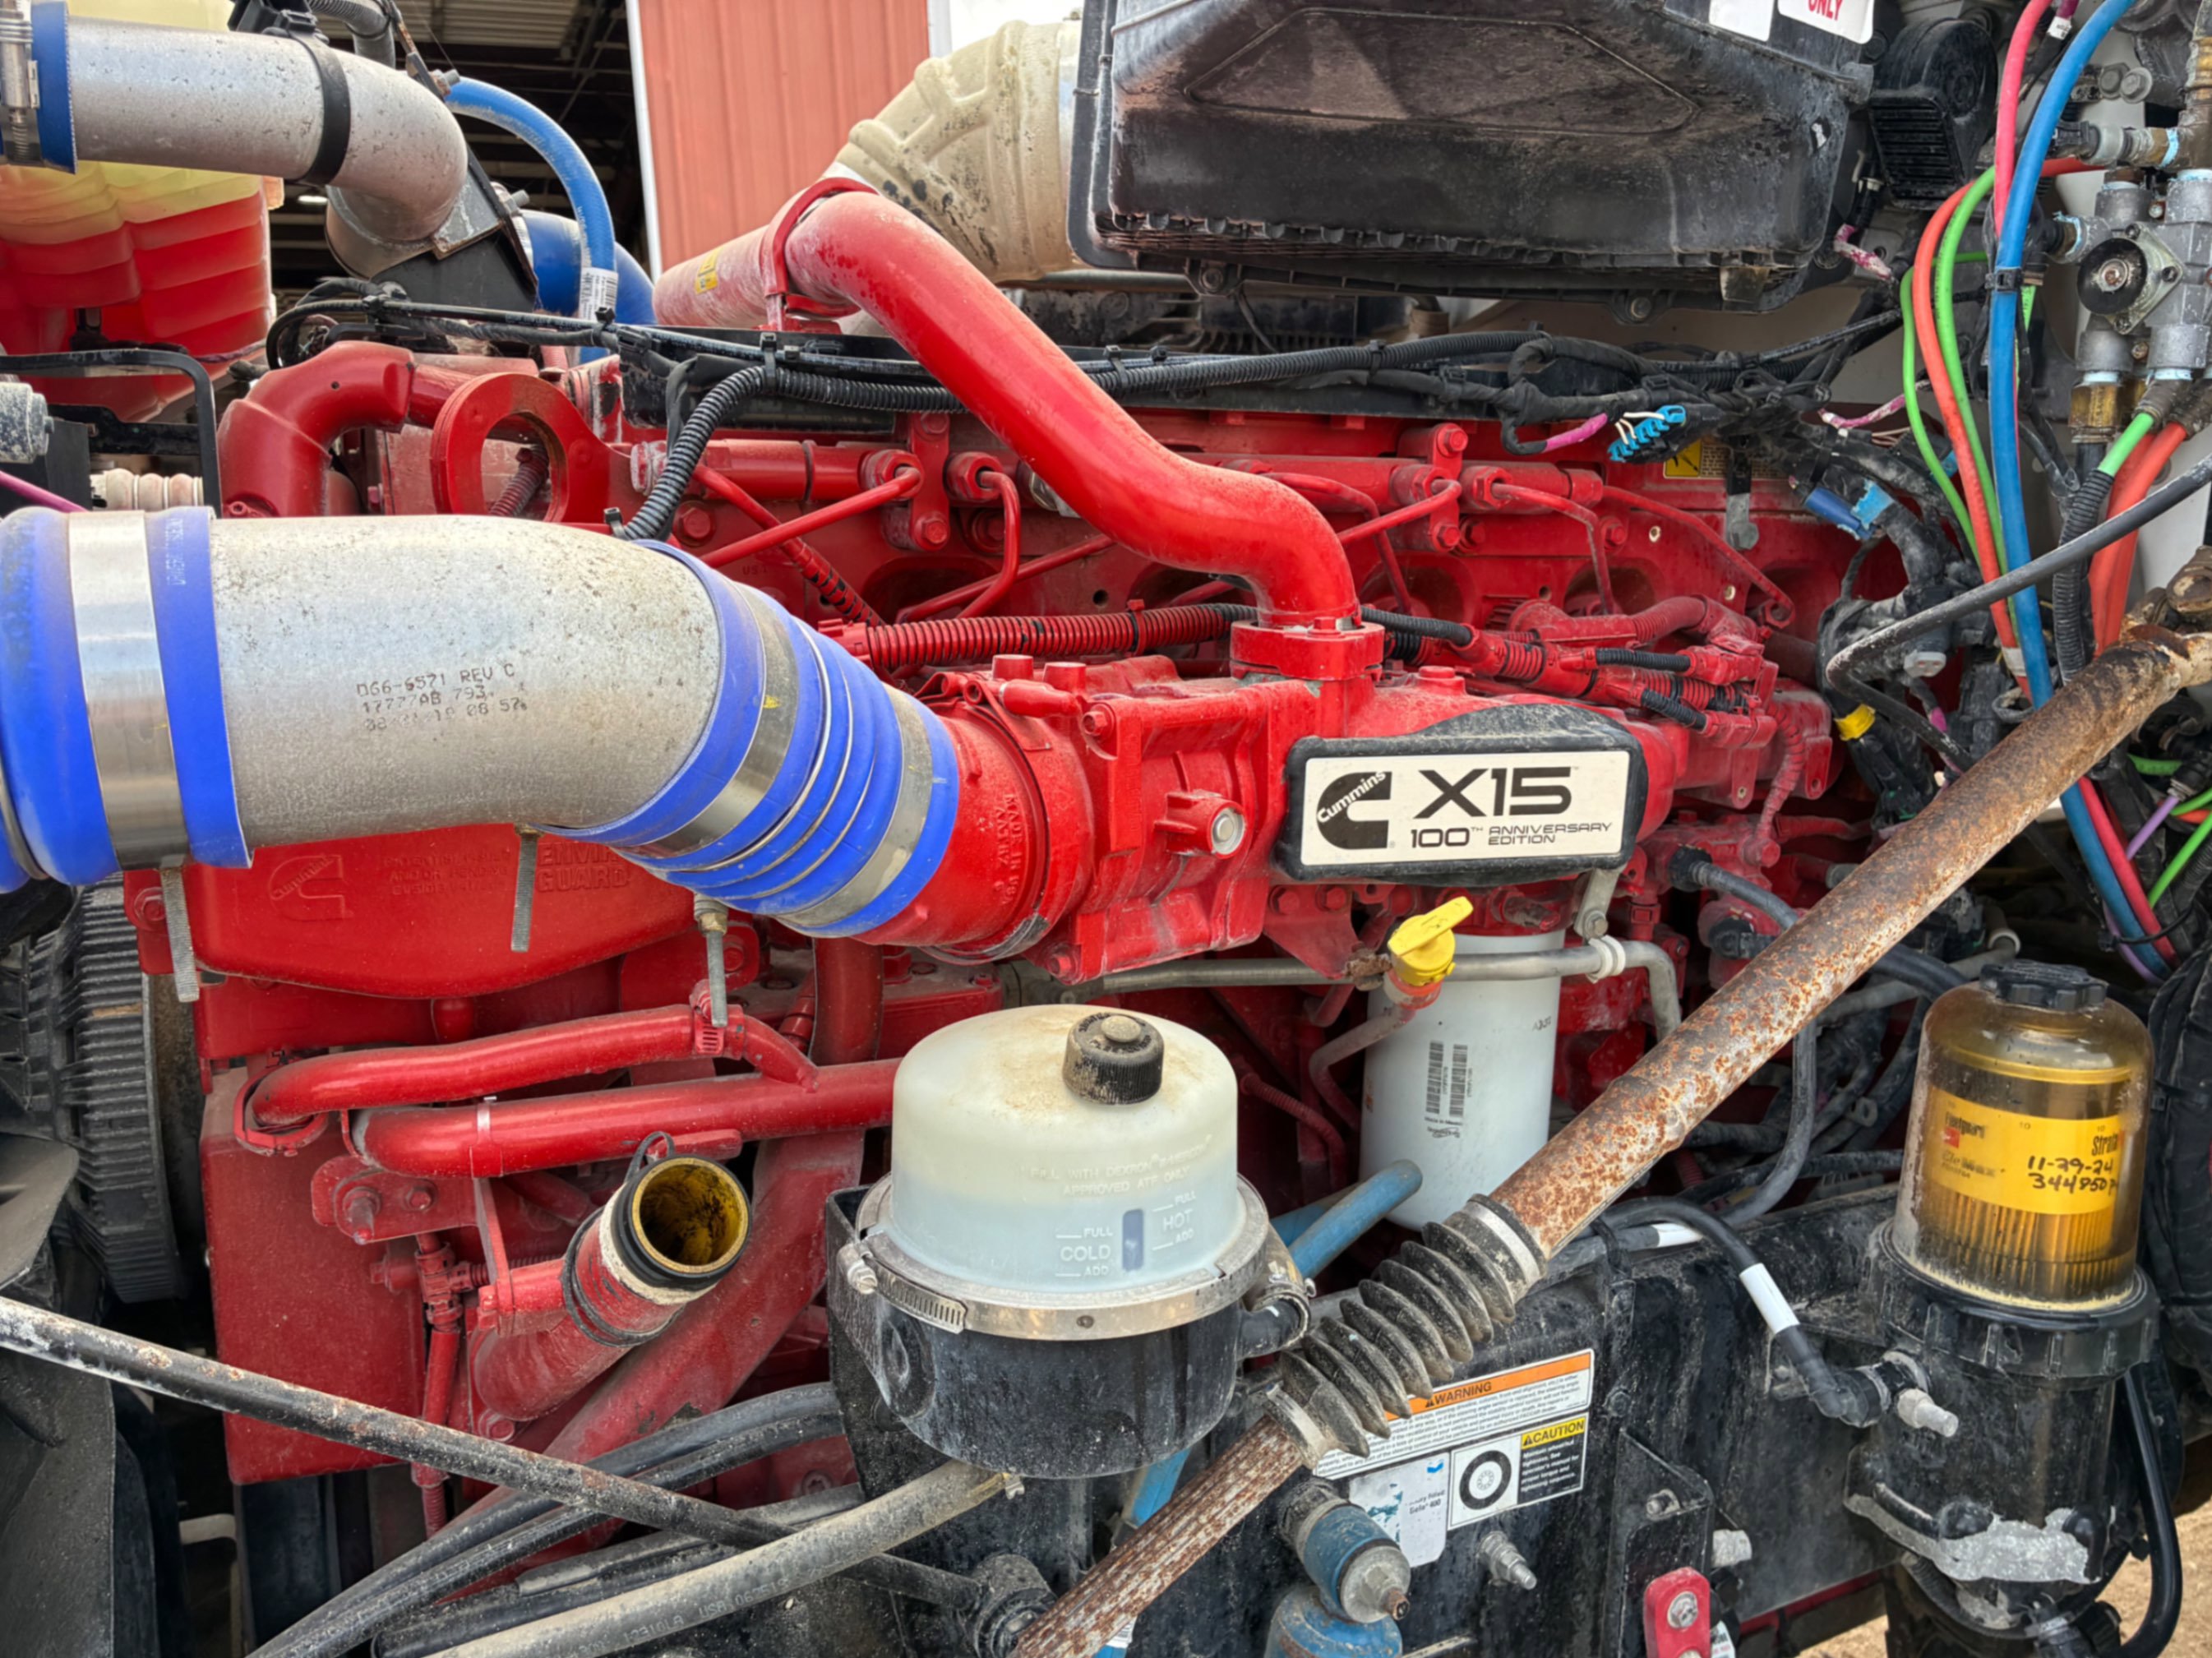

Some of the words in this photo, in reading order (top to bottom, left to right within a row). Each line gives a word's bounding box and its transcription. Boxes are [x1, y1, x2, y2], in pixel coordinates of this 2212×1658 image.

[1808, 0, 1842, 21] ONLY
[460, 667, 493, 683] REV
[503, 663, 515, 677] C
[1317, 770, 1386, 824] Cummins
[1414, 766, 1572, 819] X15
[1489, 822, 1613, 835] ANNIVERSARY
[1489, 834, 1556, 845] EDITION
[538, 867, 630, 893] GUARD
[1062, 1180, 1130, 1198] APPROVED
[1137, 1176, 1158, 1191] ATF
[1164, 1166, 1191, 1186] ONLY
[1067, 1167, 1100, 1180] WITH
[1175, 1190, 1197, 1207] FULL
[1162, 1209, 1194, 1233] HOT
[1084, 1227, 1113, 1238] FULL
[1175, 1228, 1194, 1244] ADD
[1060, 1245, 1111, 1262] COLD
[1084, 1266, 1109, 1276] ADD
[1434, 1382, 1493, 1404] WARNING
[1532, 1419, 1585, 1439] CAUTION
